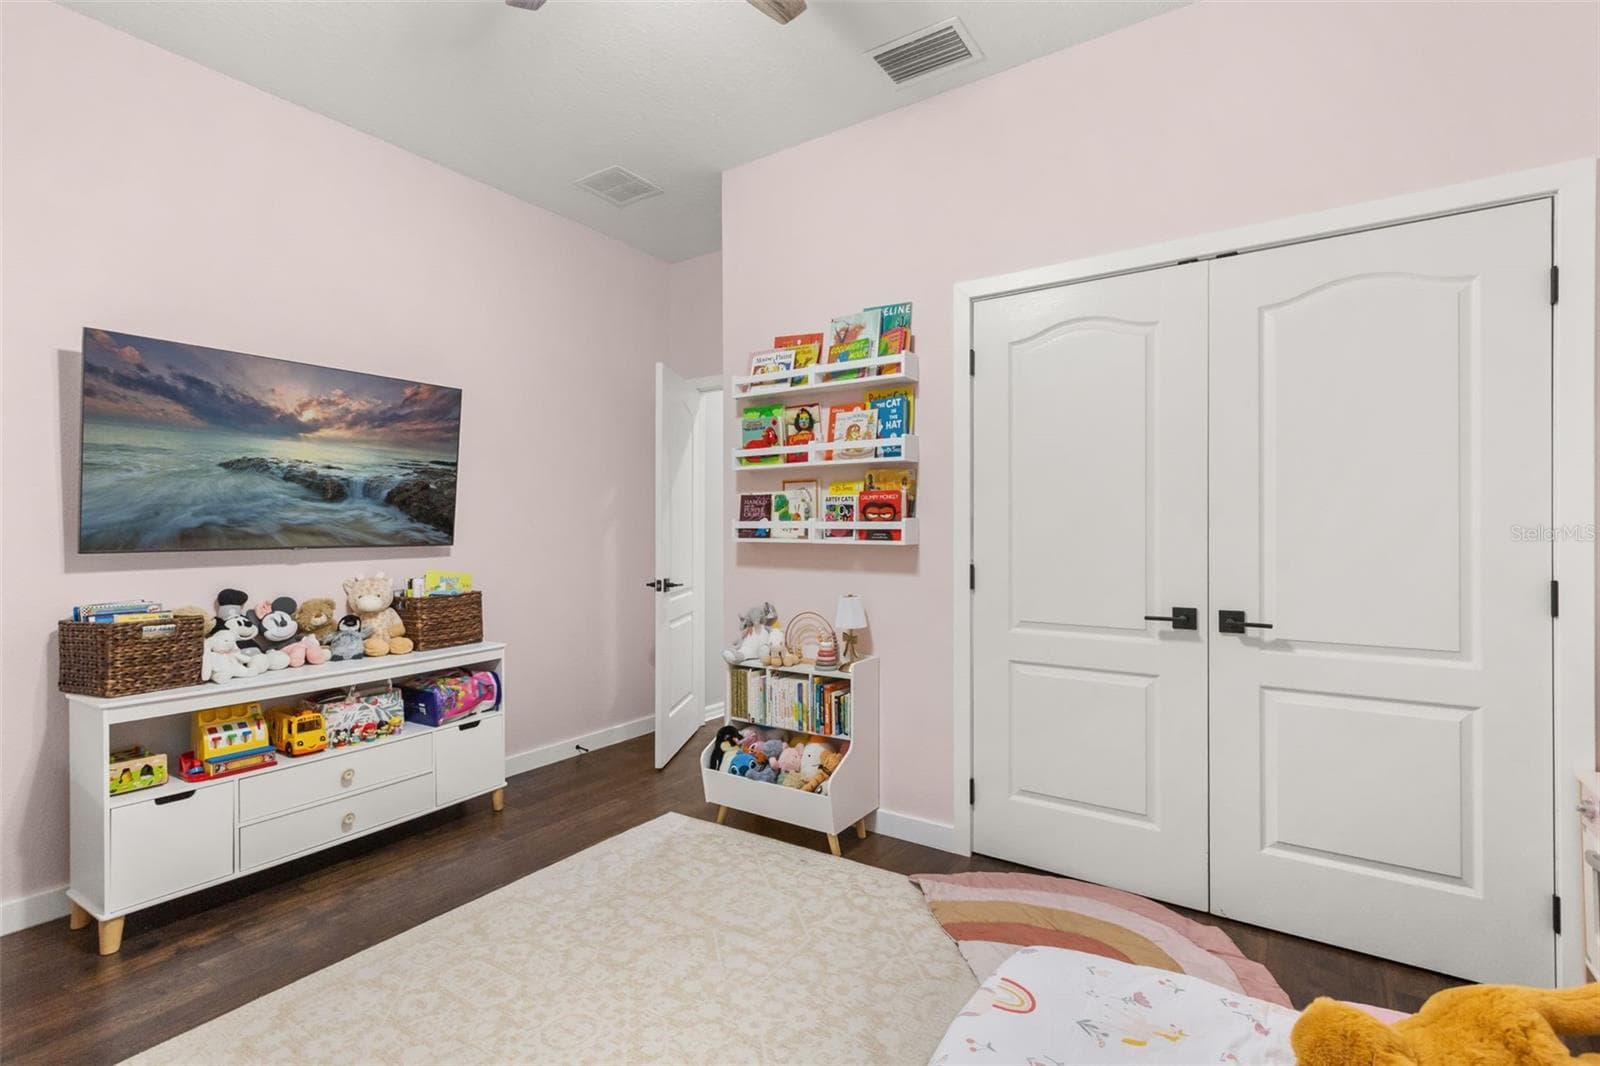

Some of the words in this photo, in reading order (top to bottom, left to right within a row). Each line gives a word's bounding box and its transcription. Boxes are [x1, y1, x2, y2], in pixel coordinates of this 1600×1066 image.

[884, 304, 911, 316] ELINE
[886, 398, 901, 408] CAT
[886, 420, 902, 430] HAT
